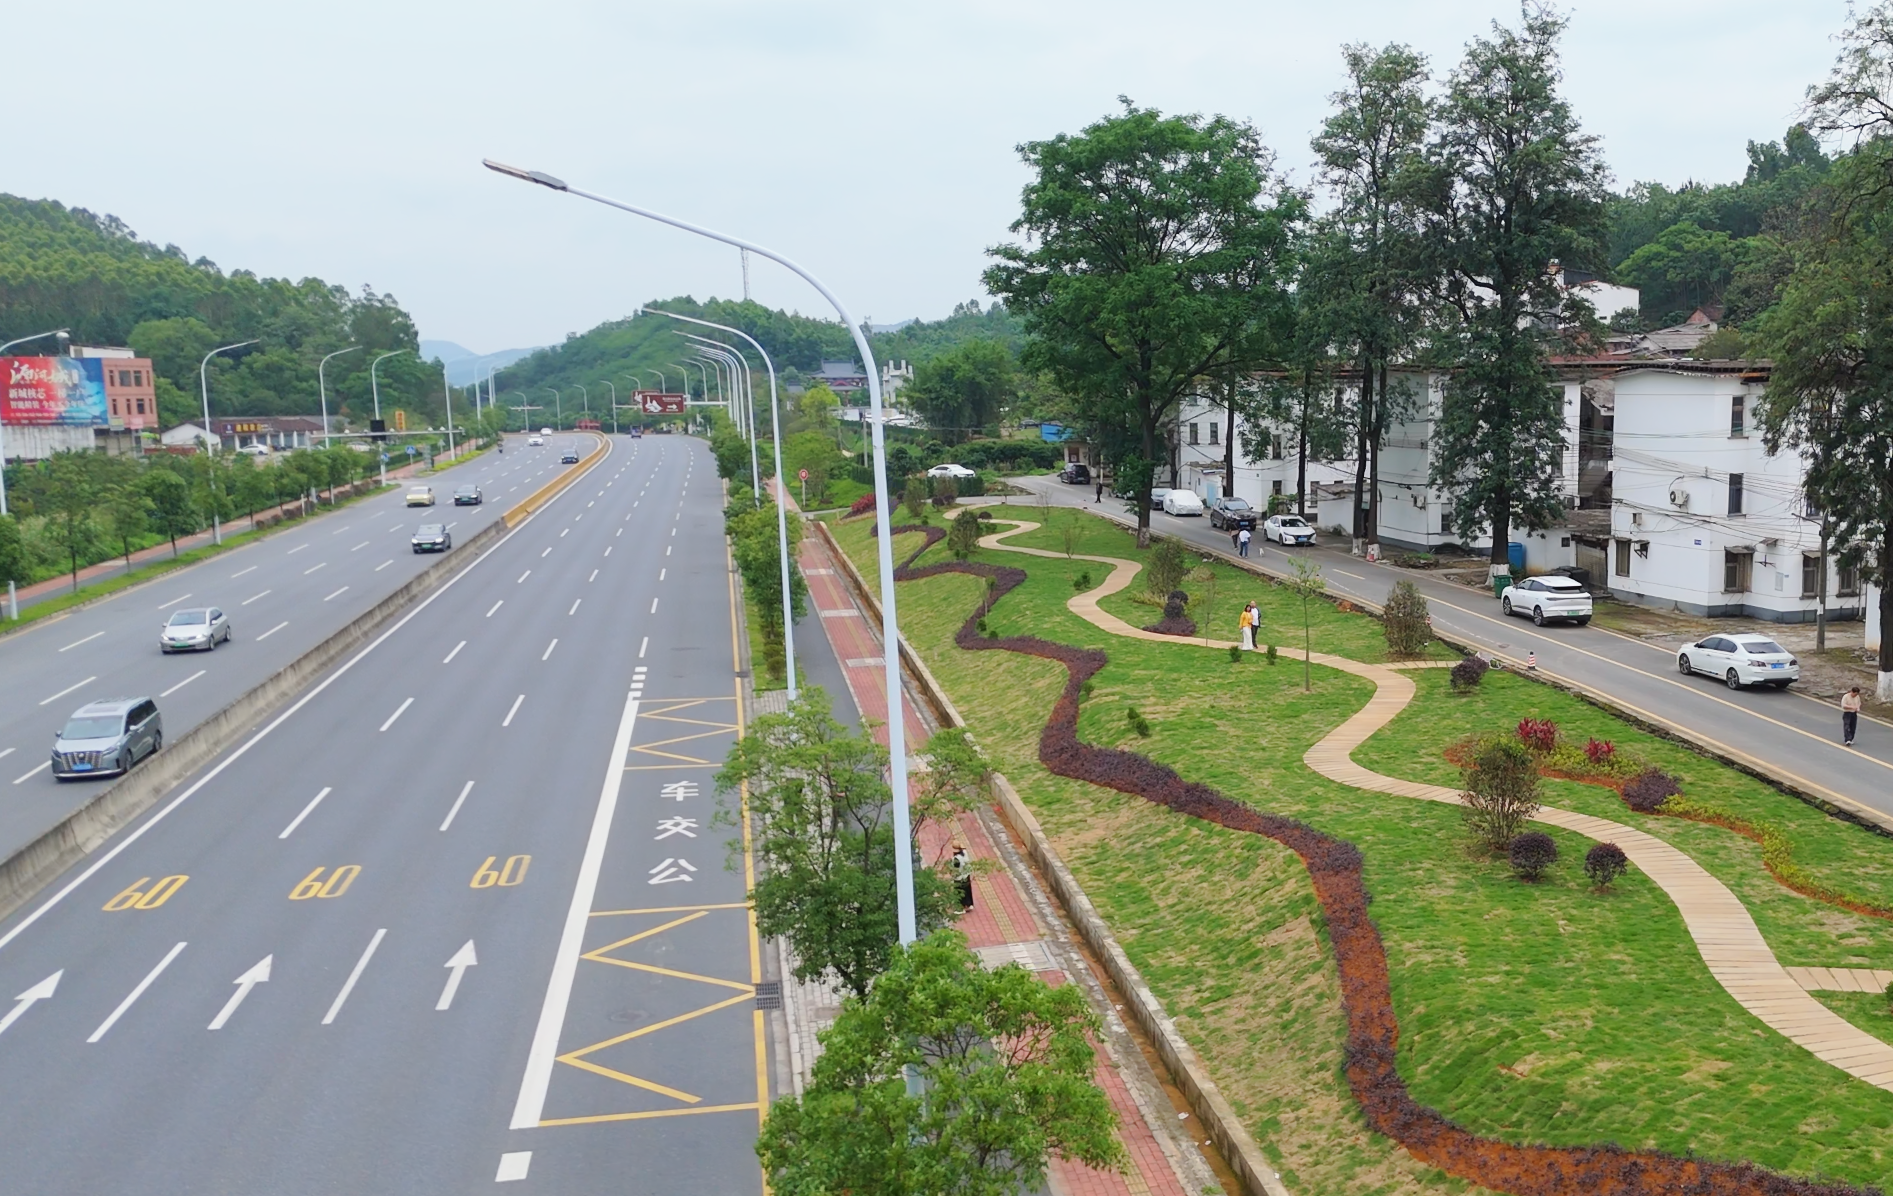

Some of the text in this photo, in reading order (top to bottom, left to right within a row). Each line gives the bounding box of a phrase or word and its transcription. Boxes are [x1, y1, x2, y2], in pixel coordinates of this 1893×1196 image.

[288, 864, 361, 900] 60
[469, 854, 532, 889] 60
[102, 874, 190, 912] 60
